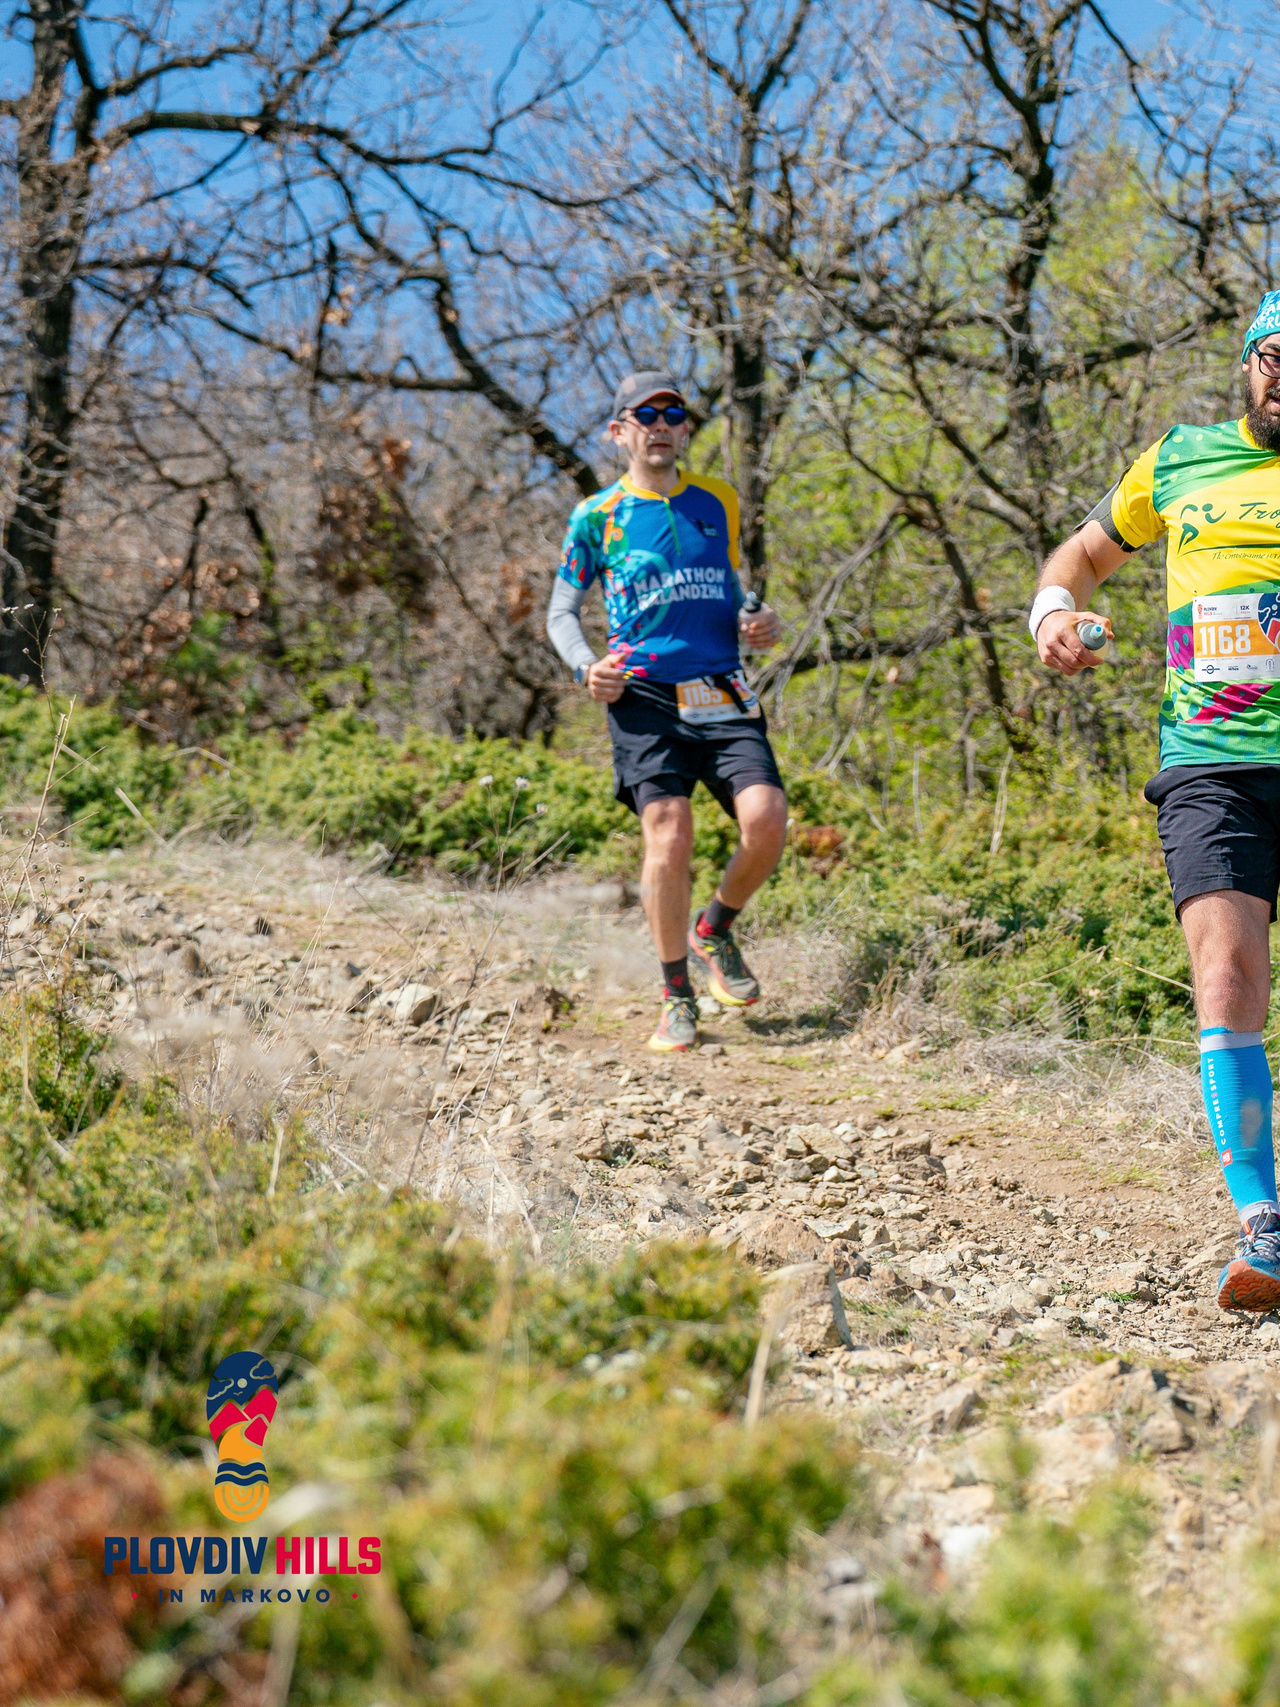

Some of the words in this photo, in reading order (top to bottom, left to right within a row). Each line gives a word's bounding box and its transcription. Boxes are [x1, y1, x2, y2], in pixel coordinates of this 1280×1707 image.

[633, 566, 726, 595] MARATHON
[1199, 624, 1251, 656] 1168
[684, 684, 723, 706] 1165
[1207, 1058, 1226, 1145] COMPRESSPORT
